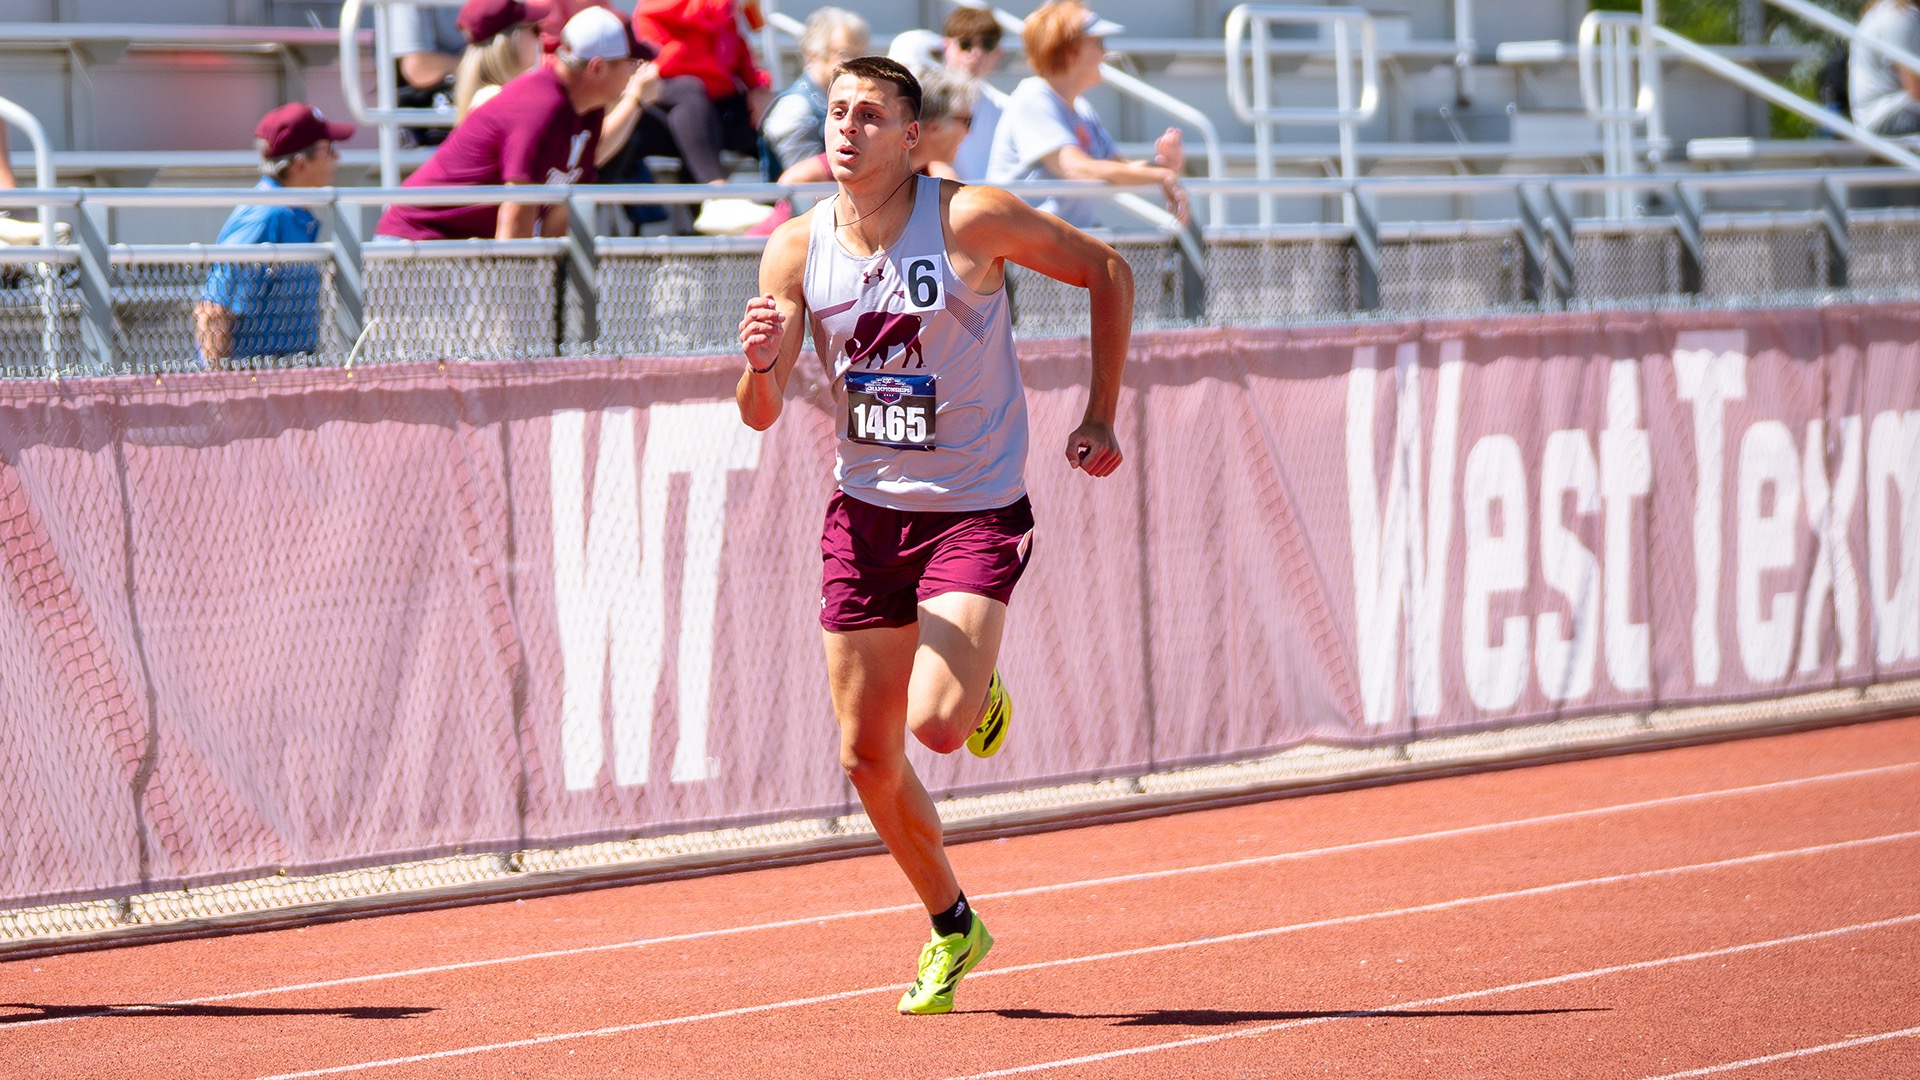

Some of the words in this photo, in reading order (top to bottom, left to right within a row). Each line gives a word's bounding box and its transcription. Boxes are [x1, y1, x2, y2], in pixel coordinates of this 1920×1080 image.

[908, 259, 938, 308] 6
[853, 403, 928, 443] 1465
[550, 402, 761, 791] WT
[1346, 340, 1653, 724] West
